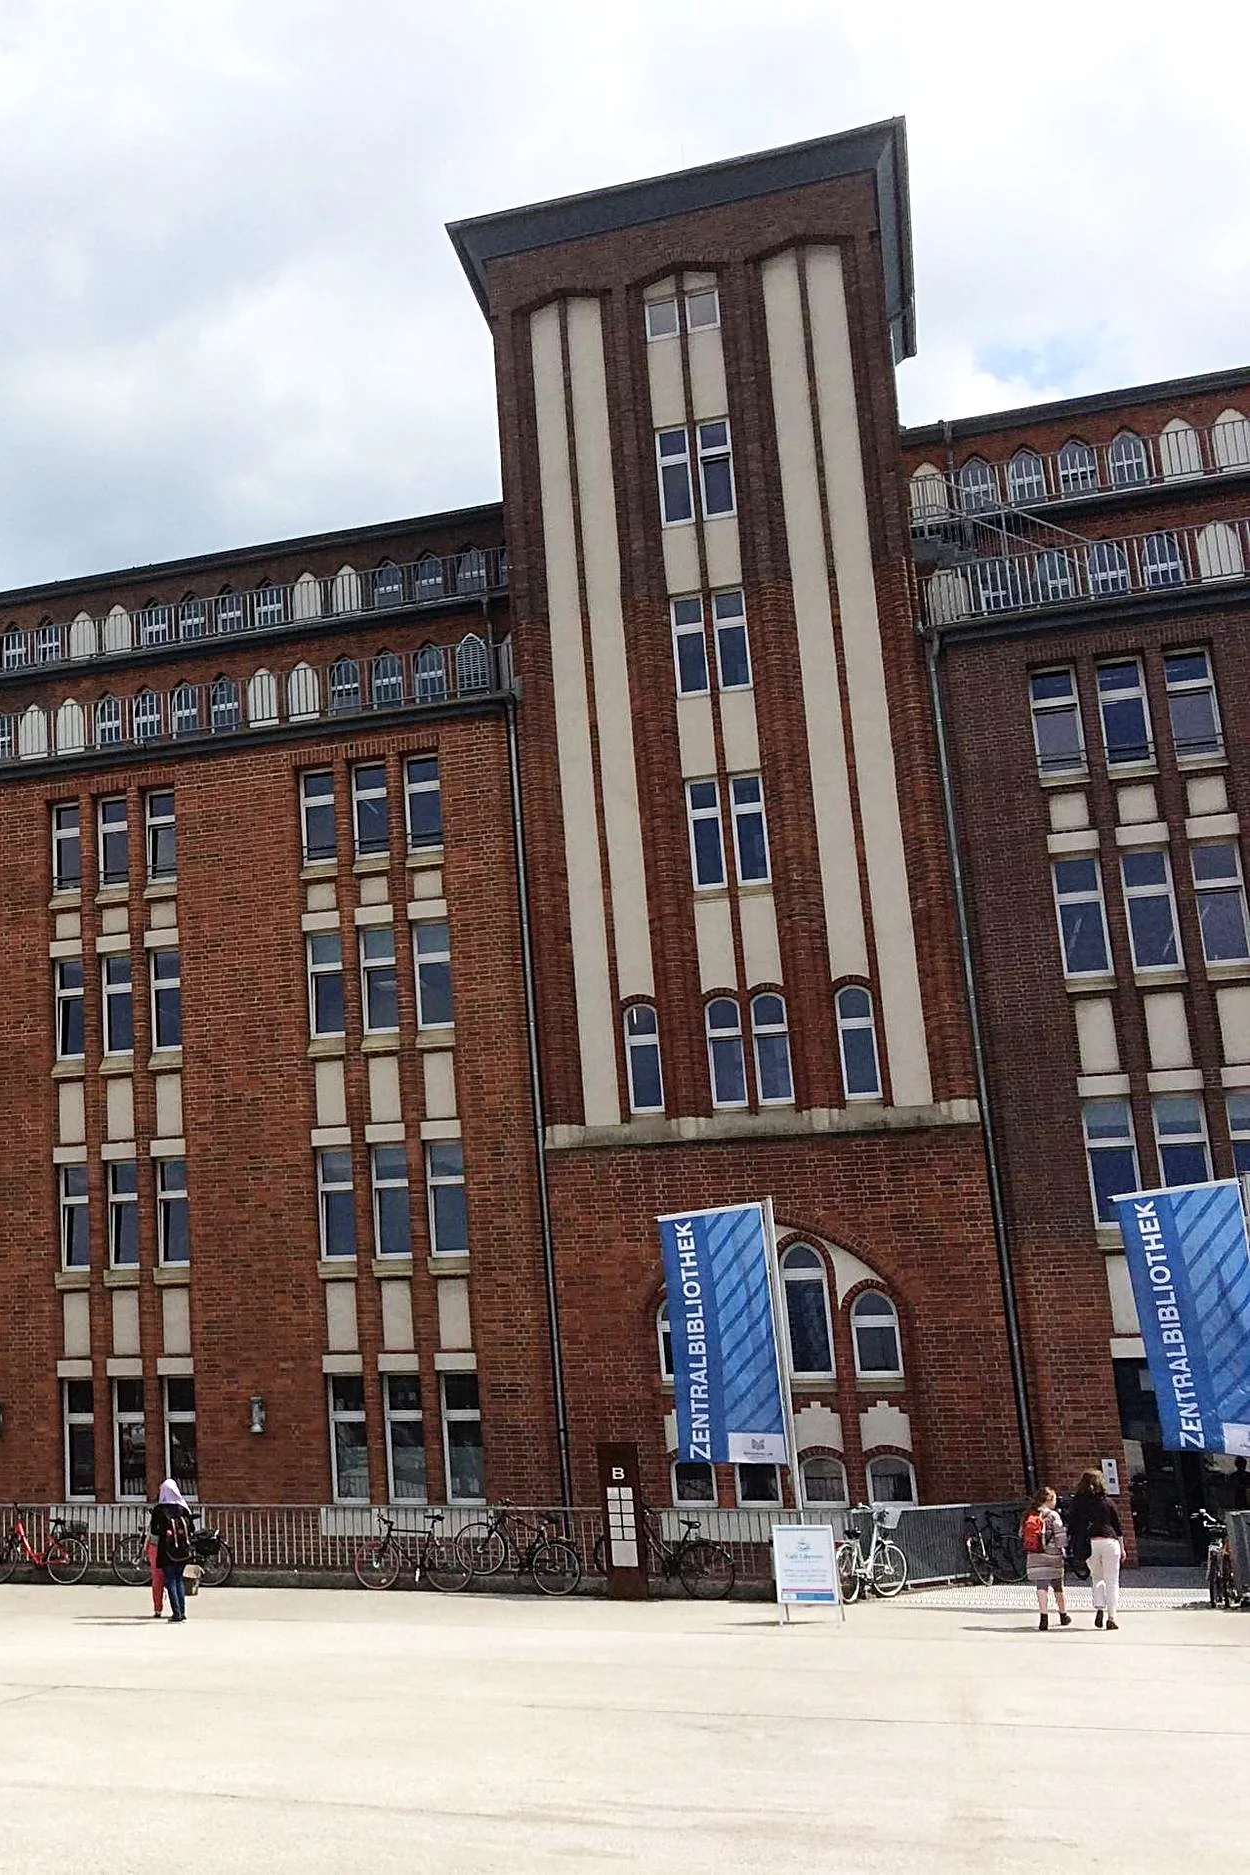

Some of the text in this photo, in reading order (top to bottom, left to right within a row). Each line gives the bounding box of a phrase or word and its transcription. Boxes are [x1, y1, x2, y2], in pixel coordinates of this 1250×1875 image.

[674, 1221, 711, 1461] ZENTRALBIBLIOTHEK
[1134, 1200, 1205, 1449] ZENTRALBIBLIOTHEK
[612, 1467, 625, 1480] B
